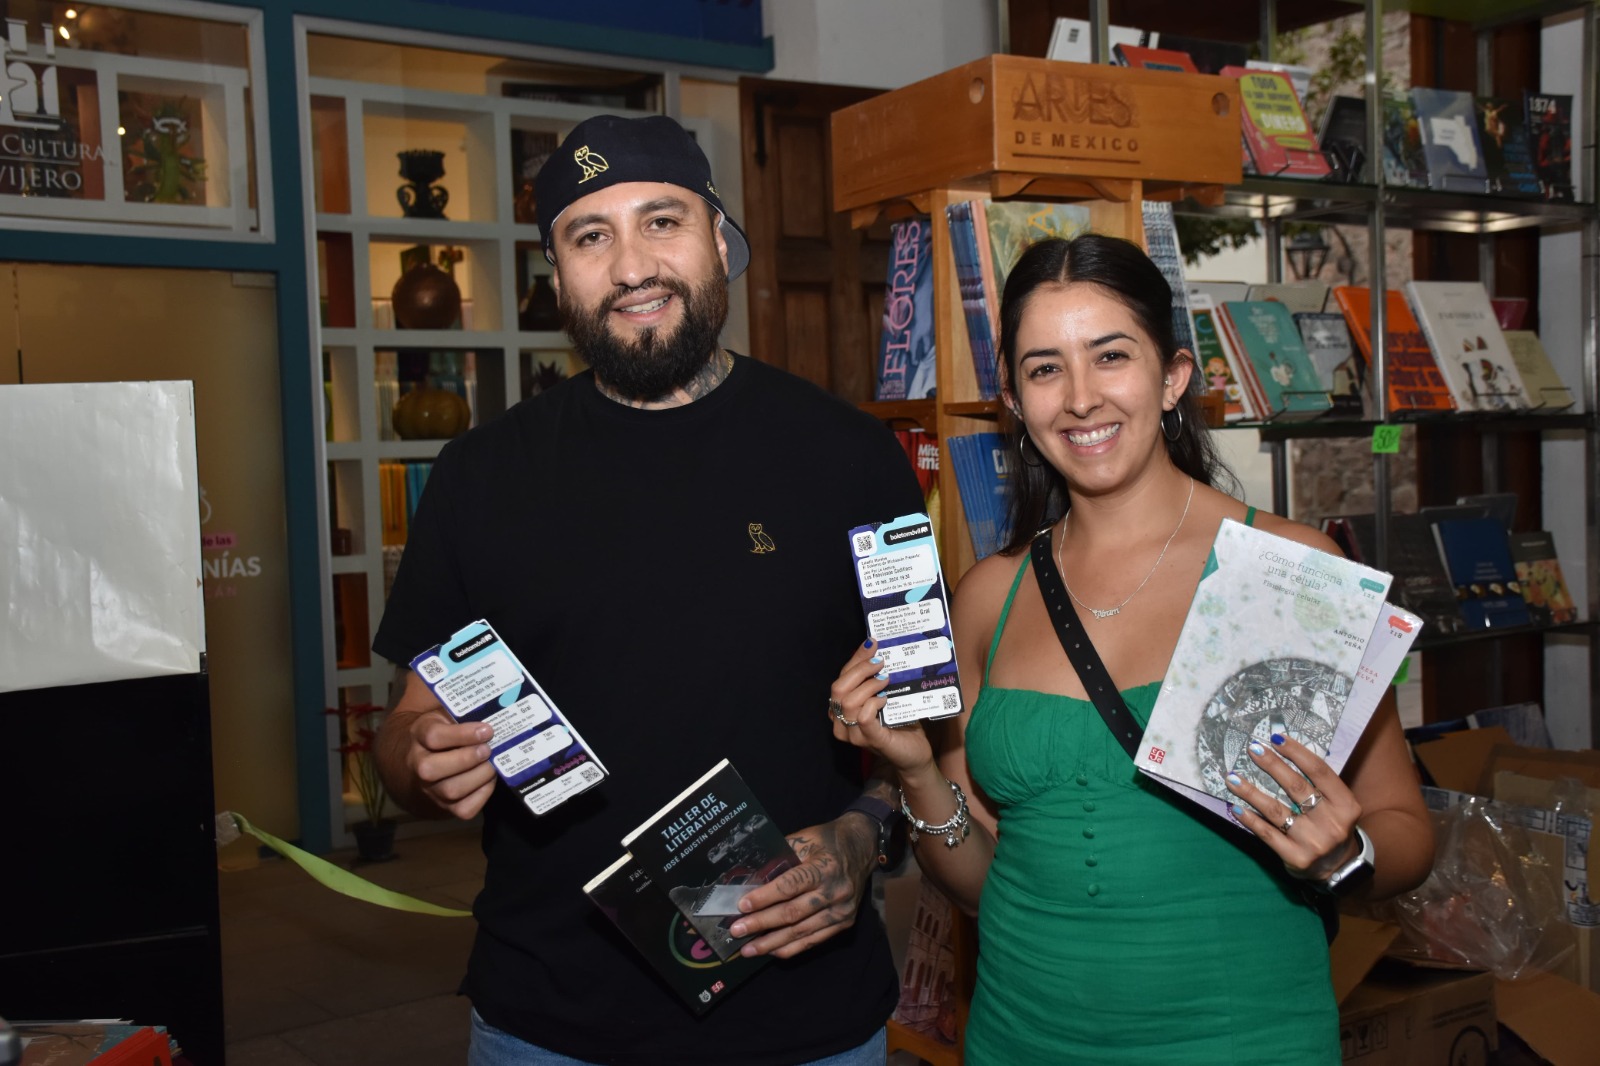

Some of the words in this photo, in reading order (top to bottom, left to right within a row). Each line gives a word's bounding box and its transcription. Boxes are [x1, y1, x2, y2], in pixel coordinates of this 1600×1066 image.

[1529, 97, 1556, 114] 1874
[1015, 131, 1042, 146] DE
[1051, 133, 1139, 152] MEXICO
[883, 220, 921, 378] FLORES
[1259, 551, 1295, 569] ¿Cómo
[1298, 562, 1343, 587] funciona
[1267, 565, 1288, 579] una
[1290, 572, 1328, 592] célula?
[1263, 579, 1296, 597] Fisiología
[1296, 593, 1321, 605] celular
[1333, 629, 1365, 644] ANTONIO
[1343, 640, 1362, 651] PEÑA
[1389, 628, 1404, 640] 118
[661, 804, 701, 839] TALLER
[700, 792, 717, 811] DE
[665, 801, 728, 853] LITERATURA
[663, 854, 681, 872] JOSÉ
[680, 834, 709, 859] AGUSTÍN
[707, 801, 748, 835] SOLÓRZANO
